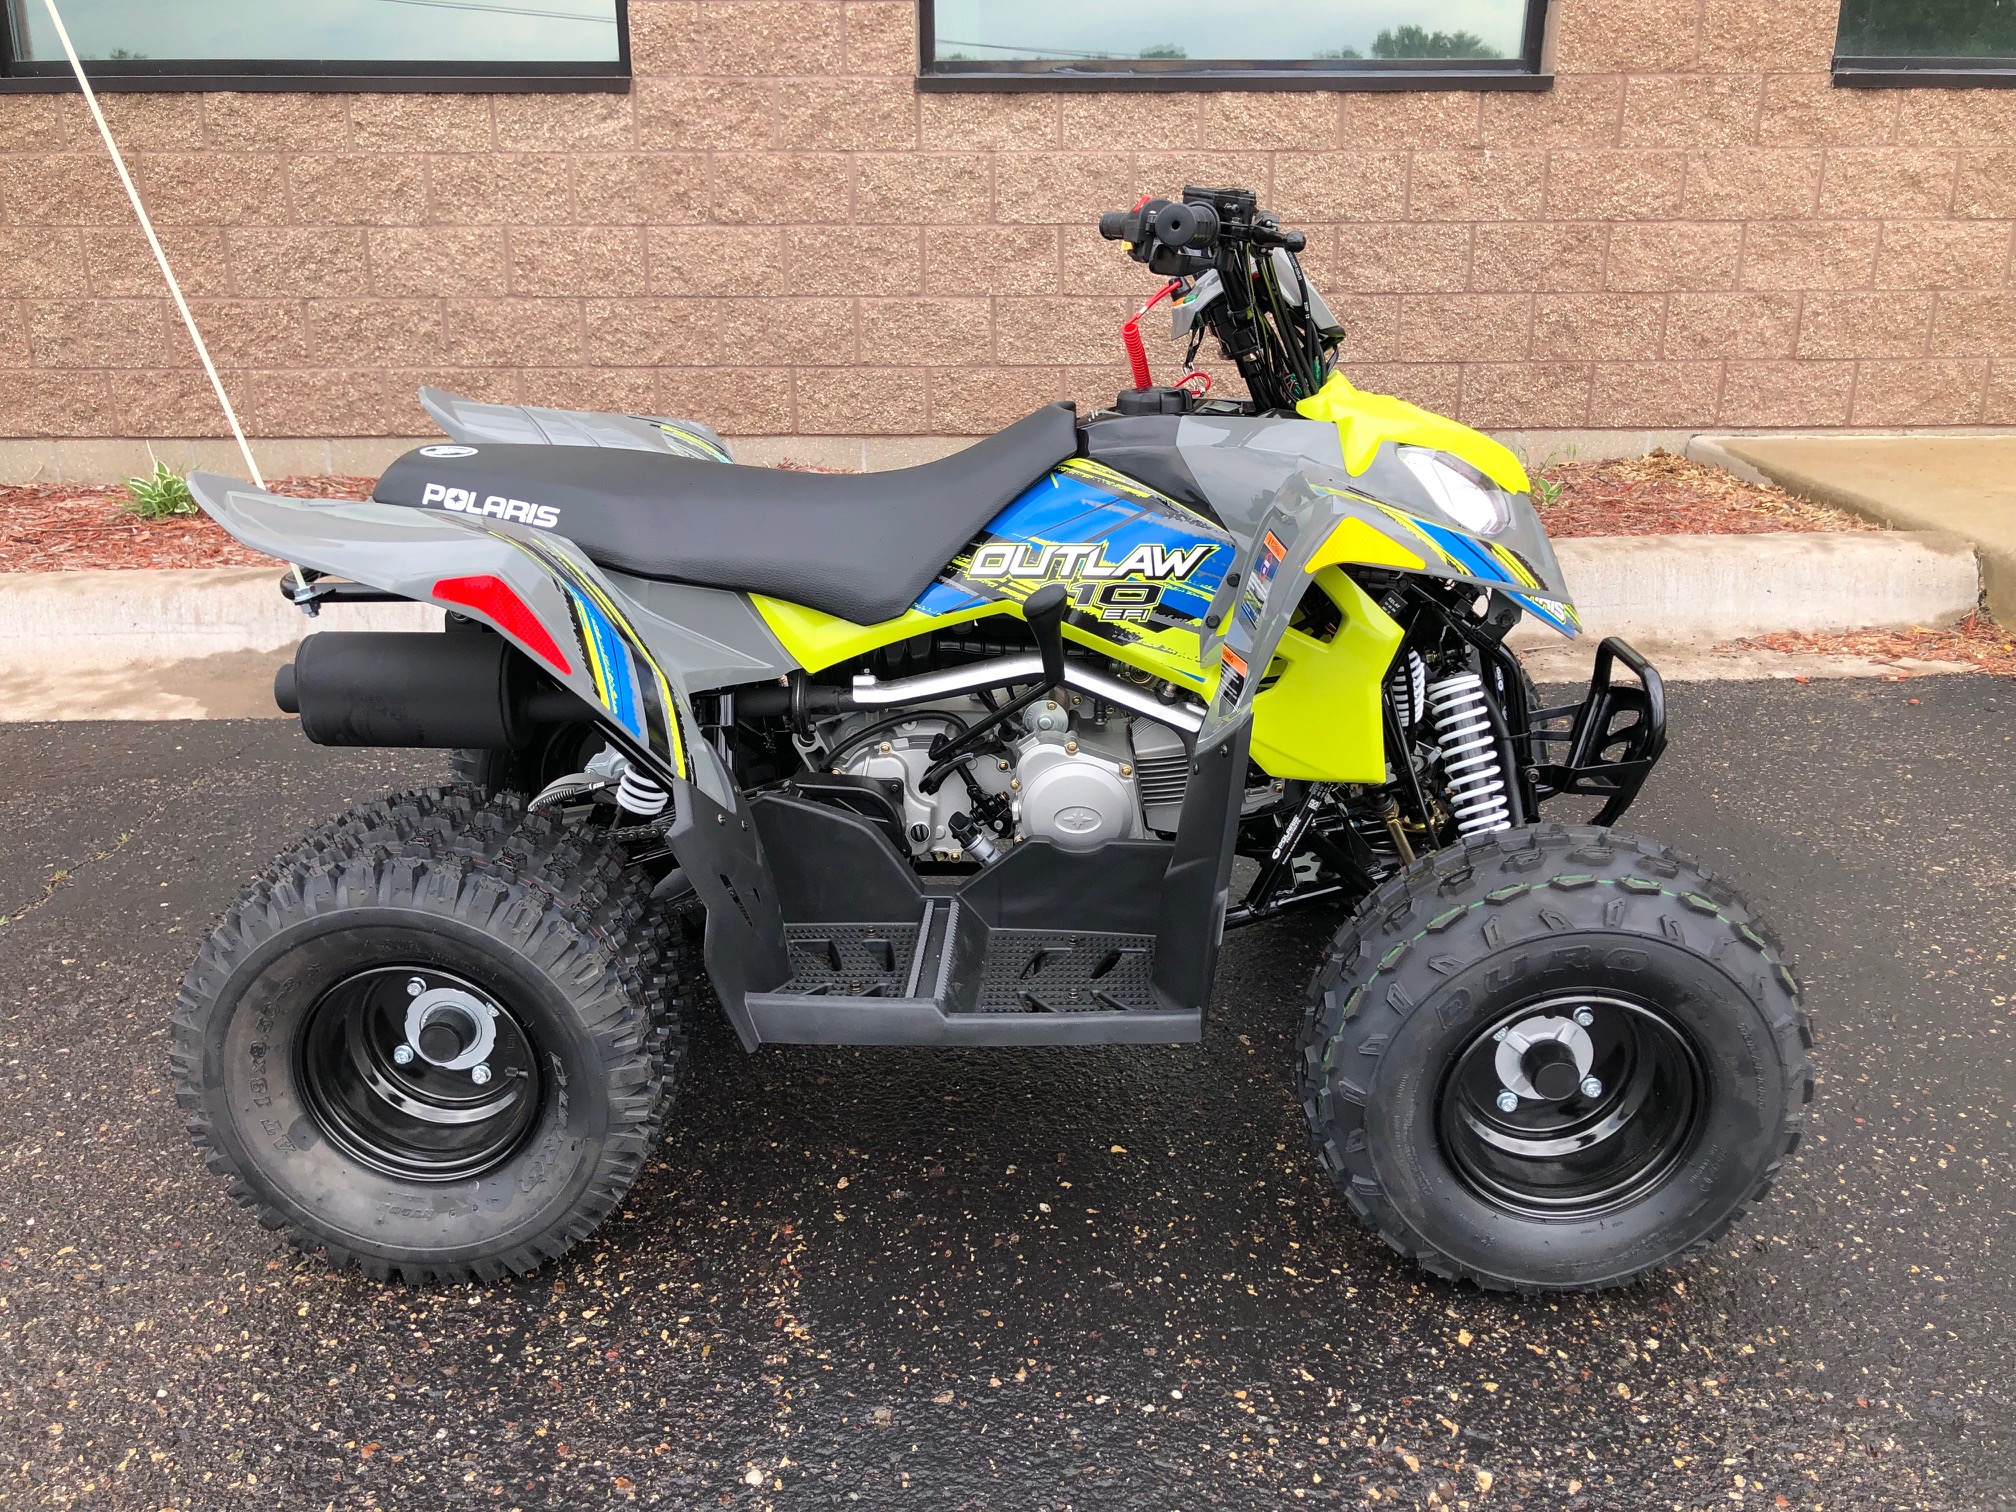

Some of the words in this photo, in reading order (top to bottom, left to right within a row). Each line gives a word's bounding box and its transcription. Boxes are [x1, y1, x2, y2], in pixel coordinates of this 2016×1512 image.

[421, 483, 561, 528] POLARIS
[967, 543, 1216, 580] OUTLAW
[1040, 580, 1166, 608] 10
[1100, 607, 1152, 622] EFI
[1434, 944, 1651, 1031] DURO
